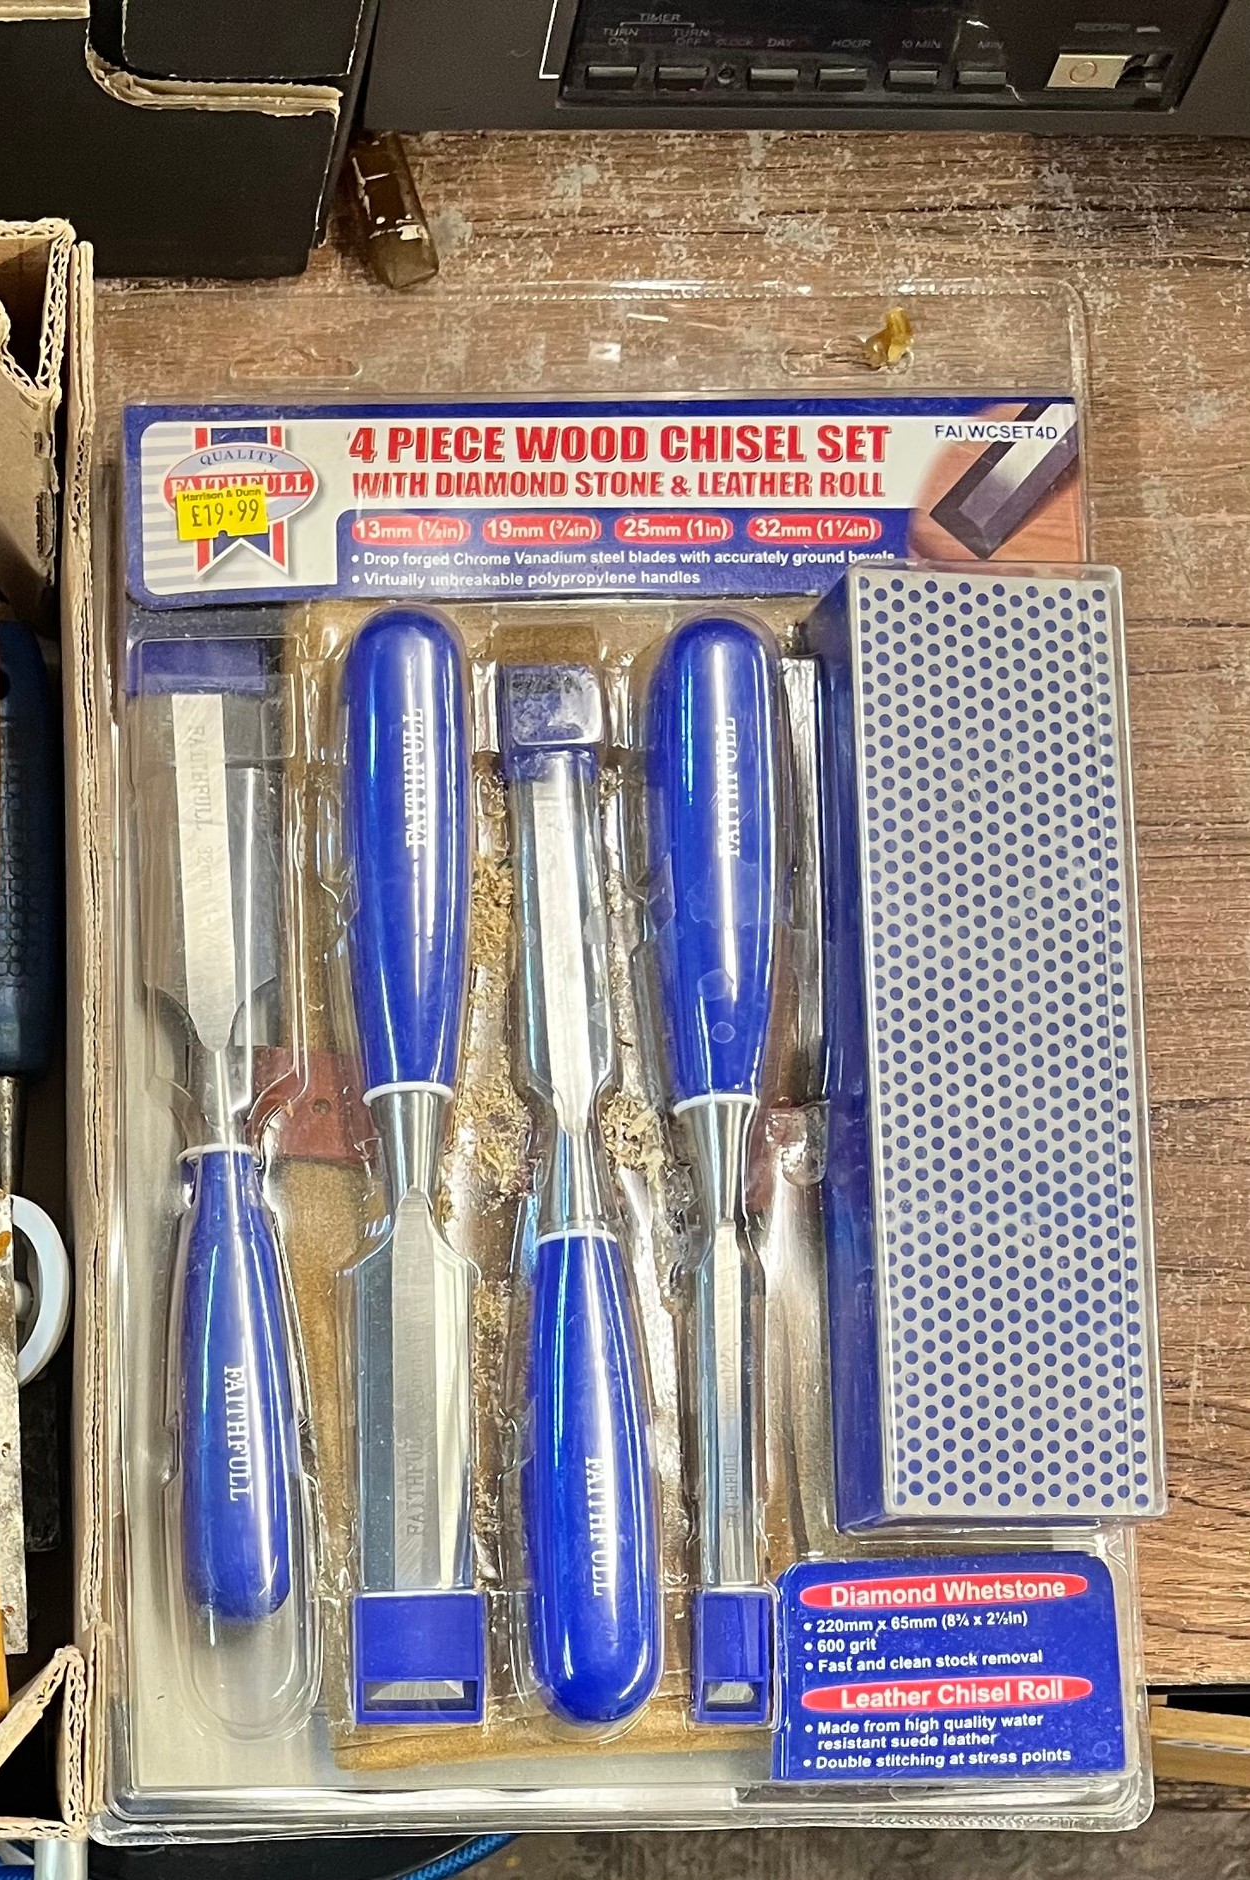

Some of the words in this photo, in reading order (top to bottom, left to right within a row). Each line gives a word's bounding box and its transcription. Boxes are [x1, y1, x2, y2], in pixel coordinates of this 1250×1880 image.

[639, 13, 681, 23] TIMER
[602, 28, 639, 37] TURN
[672, 28, 710, 37] TURN
[608, 37, 629, 46] ON
[676, 37, 704, 46] OFF
[767, 38, 795, 48] DAY
[831, 39, 871, 49] HOUR
[901, 40, 914, 49] 10
[916, 40, 942, 49] MIN
[935, 424, 963, 440] FAI
[969, 424, 1058, 441] WCSET4D
[349, 426, 377, 464] 4
[388, 426, 505, 463] PIECE
[515, 426, 648, 463] WOOD
[660, 425, 806, 463] CHISEL
[817, 425, 891, 462] SET
[200, 449, 278, 466] QUALITY
[352, 472, 423, 498] WITH
[435, 472, 568, 498] DIAMOND
[575, 471, 664, 497] STONE
[671, 474, 692, 497] &
[697, 471, 813, 497] LEATHER
[820, 471, 885, 497] ROLL
[182, 490, 224, 502] Harrison
[226, 489, 233, 498] &
[355, 520, 412, 540] 13mm
[487, 520, 544, 539] 19mm
[623, 519, 681, 538] 25mm
[686, 518, 728, 539] (1in)
[755, 519, 812, 538] 32mm
[364, 552, 399, 569] Drop
[403, 551, 450, 568] forged
[453, 552, 510, 566] Chrome
[514, 551, 586, 566] Vanadium
[591, 551, 624, 565] steel
[629, 551, 676, 565] blades
[680, 551, 710, 564] with
[714, 550, 789, 567] accurately
[792, 551, 845, 566] ground
[364, 572, 426, 589] Virtually
[430, 571, 524, 587] unbreakable
[528, 571, 636, 588] polypropylene
[641, 571, 701, 584] handles
[403, 708, 427, 848] FAITHFULL
[224, 1365, 251, 1502] FAITHFULL
[585, 1456, 611, 1597] FAITHFULL
[831, 1584, 937, 1607] Diamond
[942, 1579, 1066, 1602] Whetstone
[816, 1618, 873, 1633] 220mm
[877, 1620, 887, 1632] x
[890, 1615, 937, 1630] 65mm
[973, 1615, 982, 1626] x
[817, 1638, 845, 1653] 600
[849, 1637, 877, 1655] grit
[818, 1658, 853, 1673] Fast
[856, 1656, 886, 1671] and
[890, 1655, 932, 1670] clean
[936, 1652, 978, 1667] stock
[981, 1649, 1043, 1666] removal
[840, 1687, 931, 1709] Leather
[937, 1682, 1010, 1706] Chisel
[1018, 1679, 1064, 1701] Roll
[818, 1720, 860, 1735] Made
[863, 1718, 901, 1733] from
[904, 1716, 939, 1734] high
[943, 1714, 996, 1731] quality
[1000, 1712, 1043, 1727] water
[817, 1735, 887, 1751] resistant
[890, 1733, 938, 1748] suede
[942, 1731, 997, 1747] leather
[815, 1755, 871, 1770] Double
[875, 1752, 945, 1769] stitching
[949, 1752, 965, 1765] at
[968, 1751, 1017, 1765] stress
[1021, 1748, 1071, 1765] points
